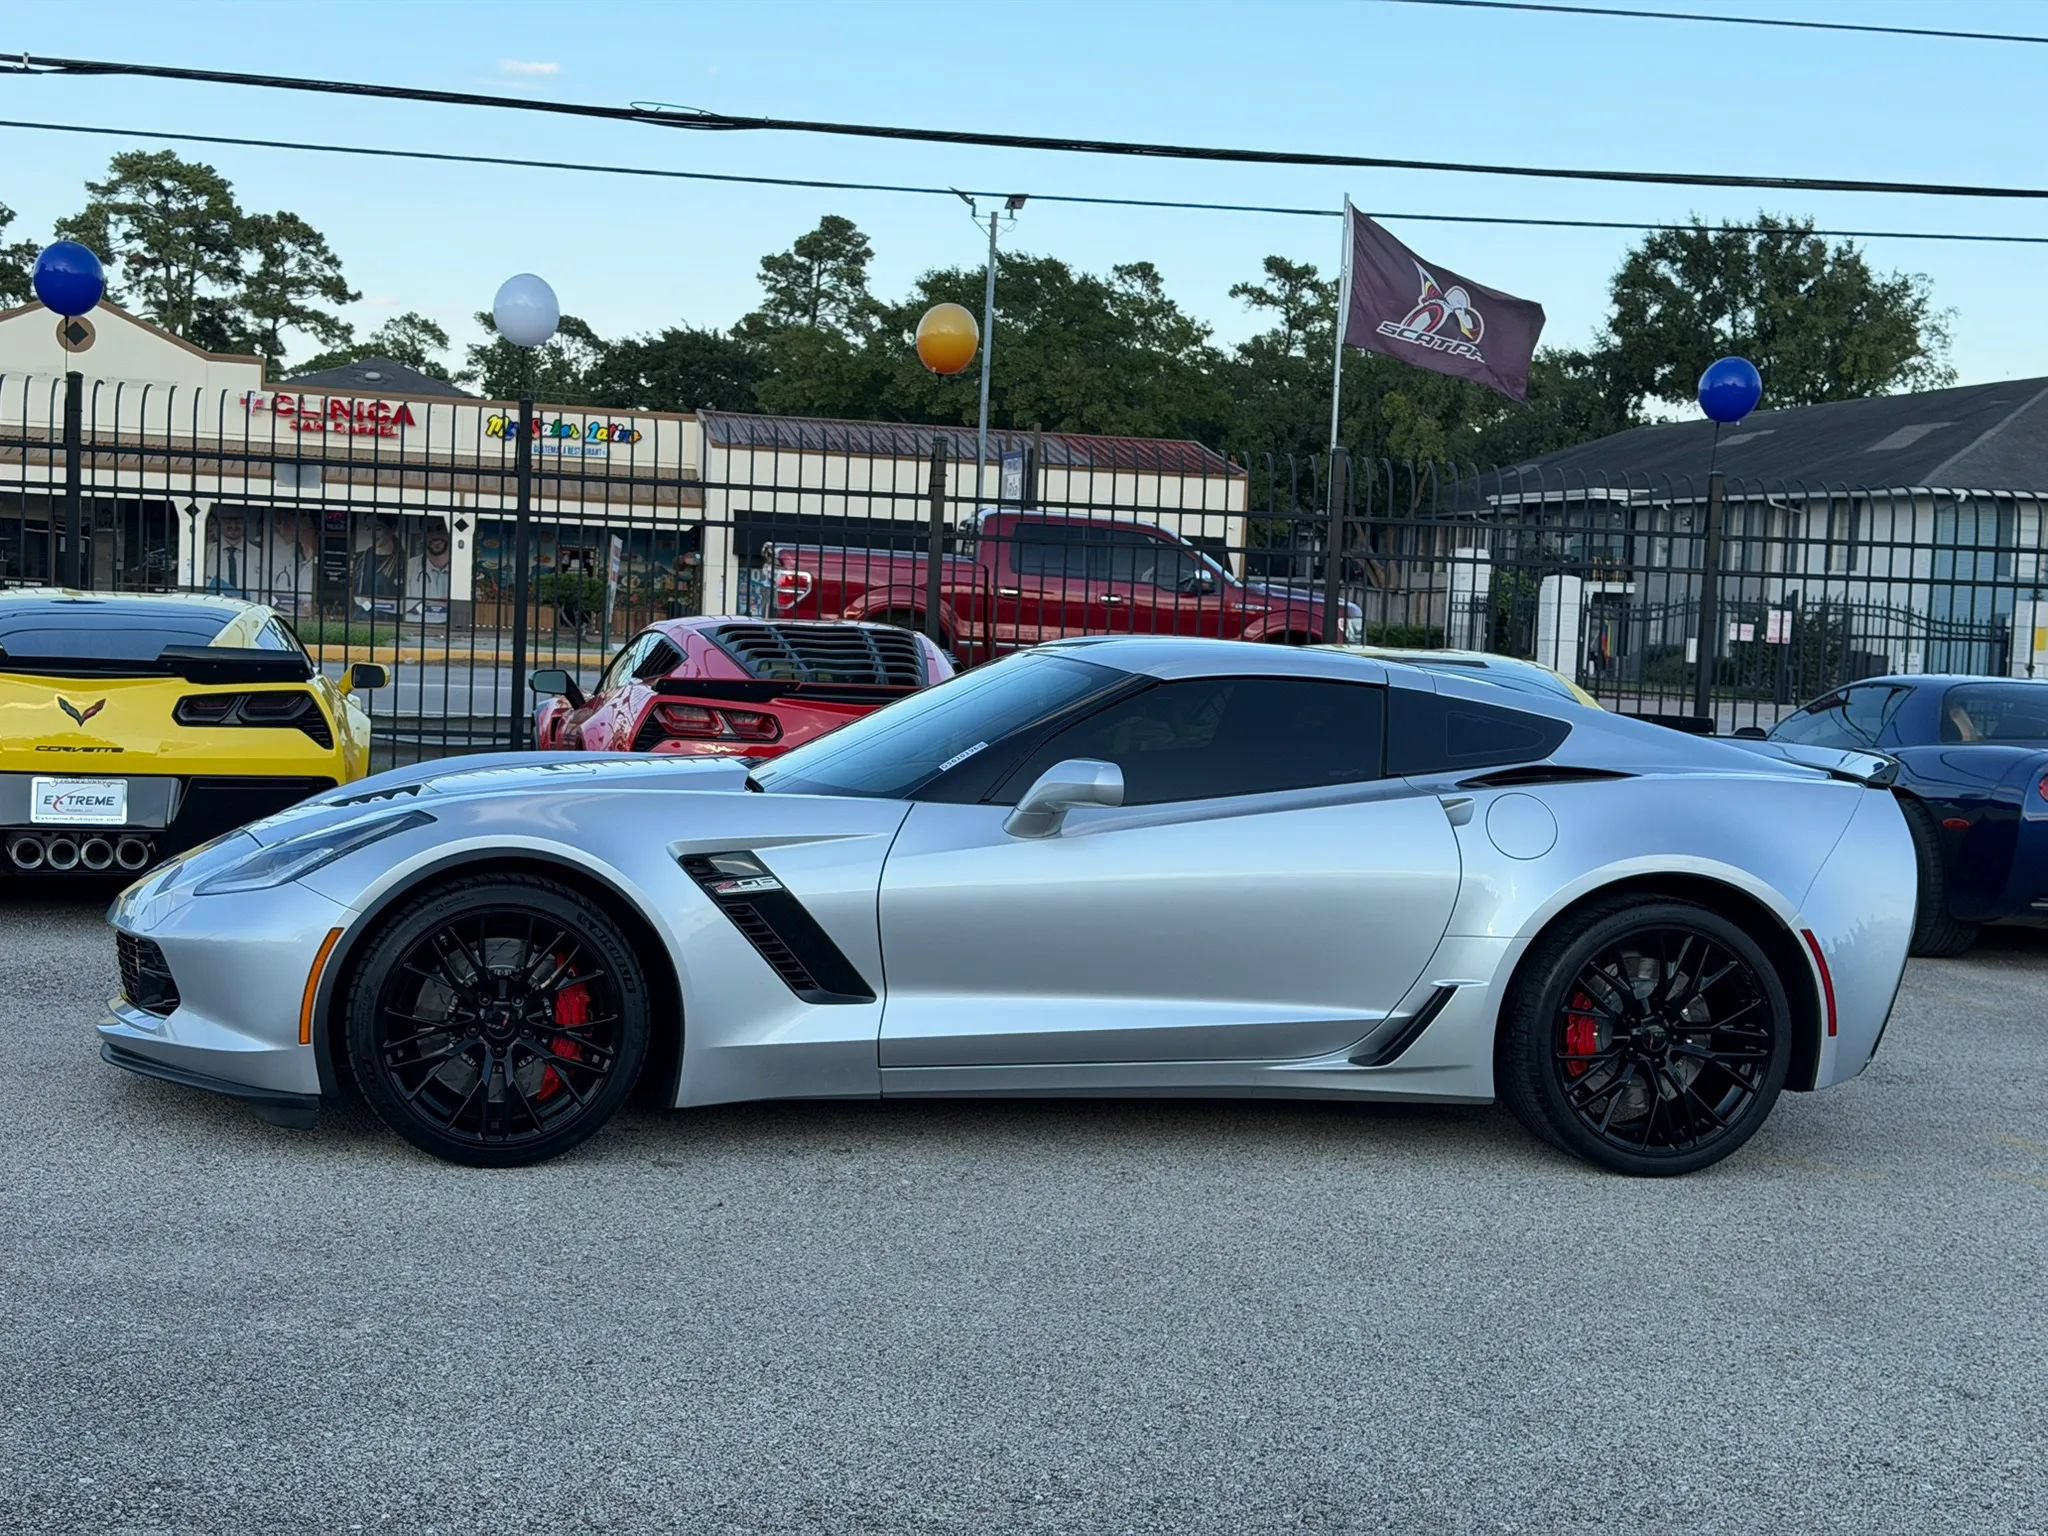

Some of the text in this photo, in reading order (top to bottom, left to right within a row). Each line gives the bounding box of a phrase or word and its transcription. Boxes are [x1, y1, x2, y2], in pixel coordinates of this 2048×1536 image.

[272, 394, 416, 427] CLINICA
[531, 417, 581, 441] Sabor
[584, 421, 643, 445] Latino
[43, 794, 116, 806] EXTREME
